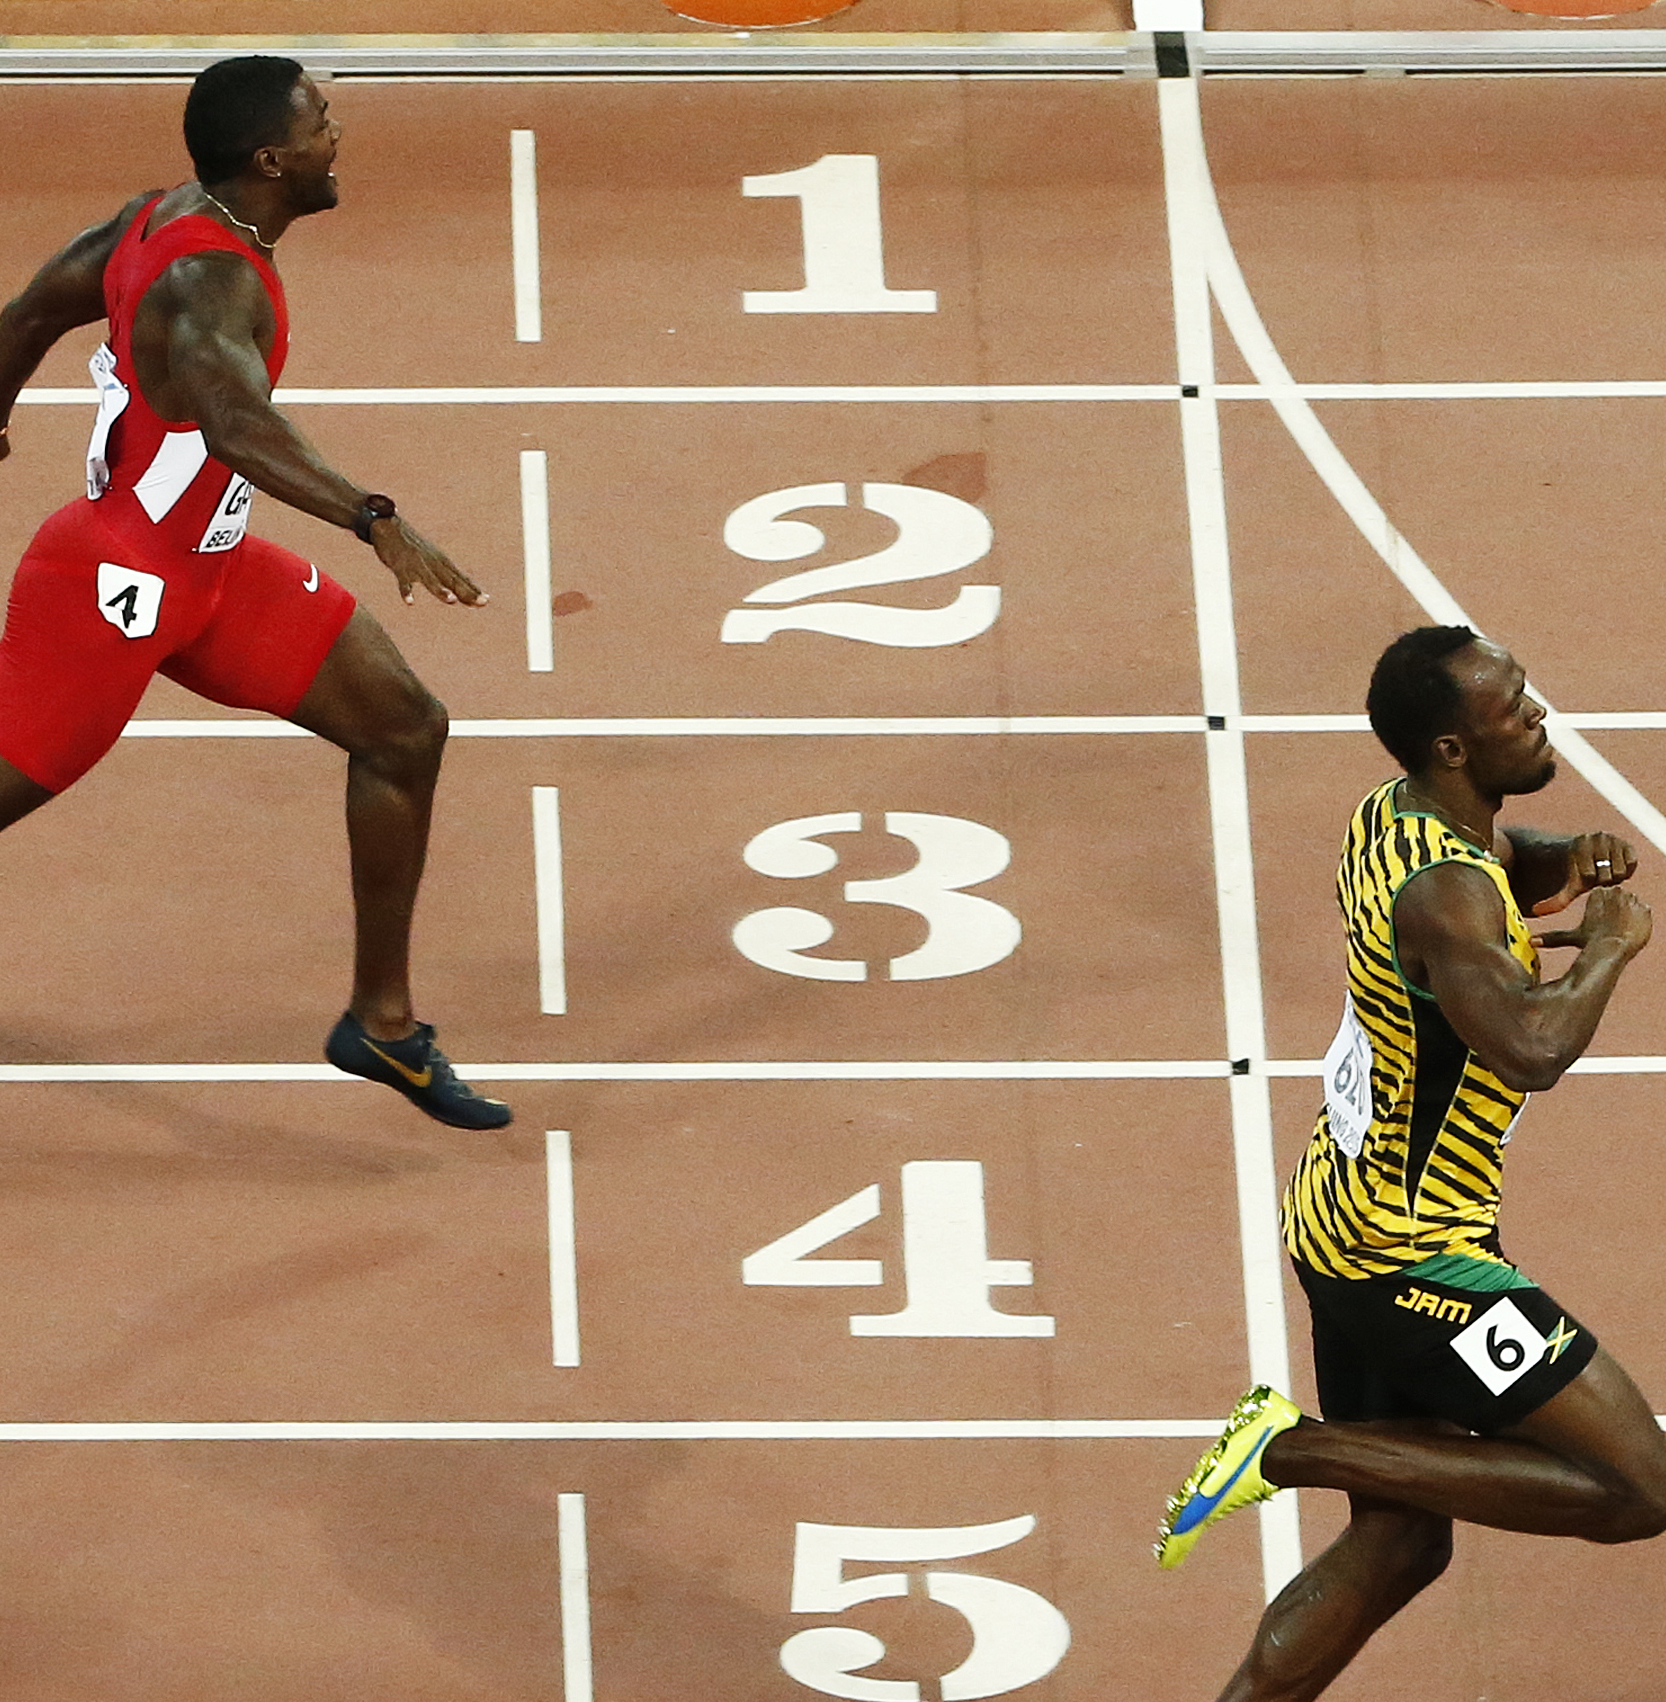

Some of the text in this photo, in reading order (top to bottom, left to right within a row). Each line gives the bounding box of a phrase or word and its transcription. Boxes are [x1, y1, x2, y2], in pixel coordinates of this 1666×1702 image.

[740, 155, 939, 316] 1
[105, 585, 139, 630] 4
[720, 482, 1004, 649] 2
[731, 812, 1023, 982] 3
[740, 1159, 1057, 1339] 4
[1394, 1287, 1473, 1325] JAM
[1486, 1324, 1526, 1373] 6
